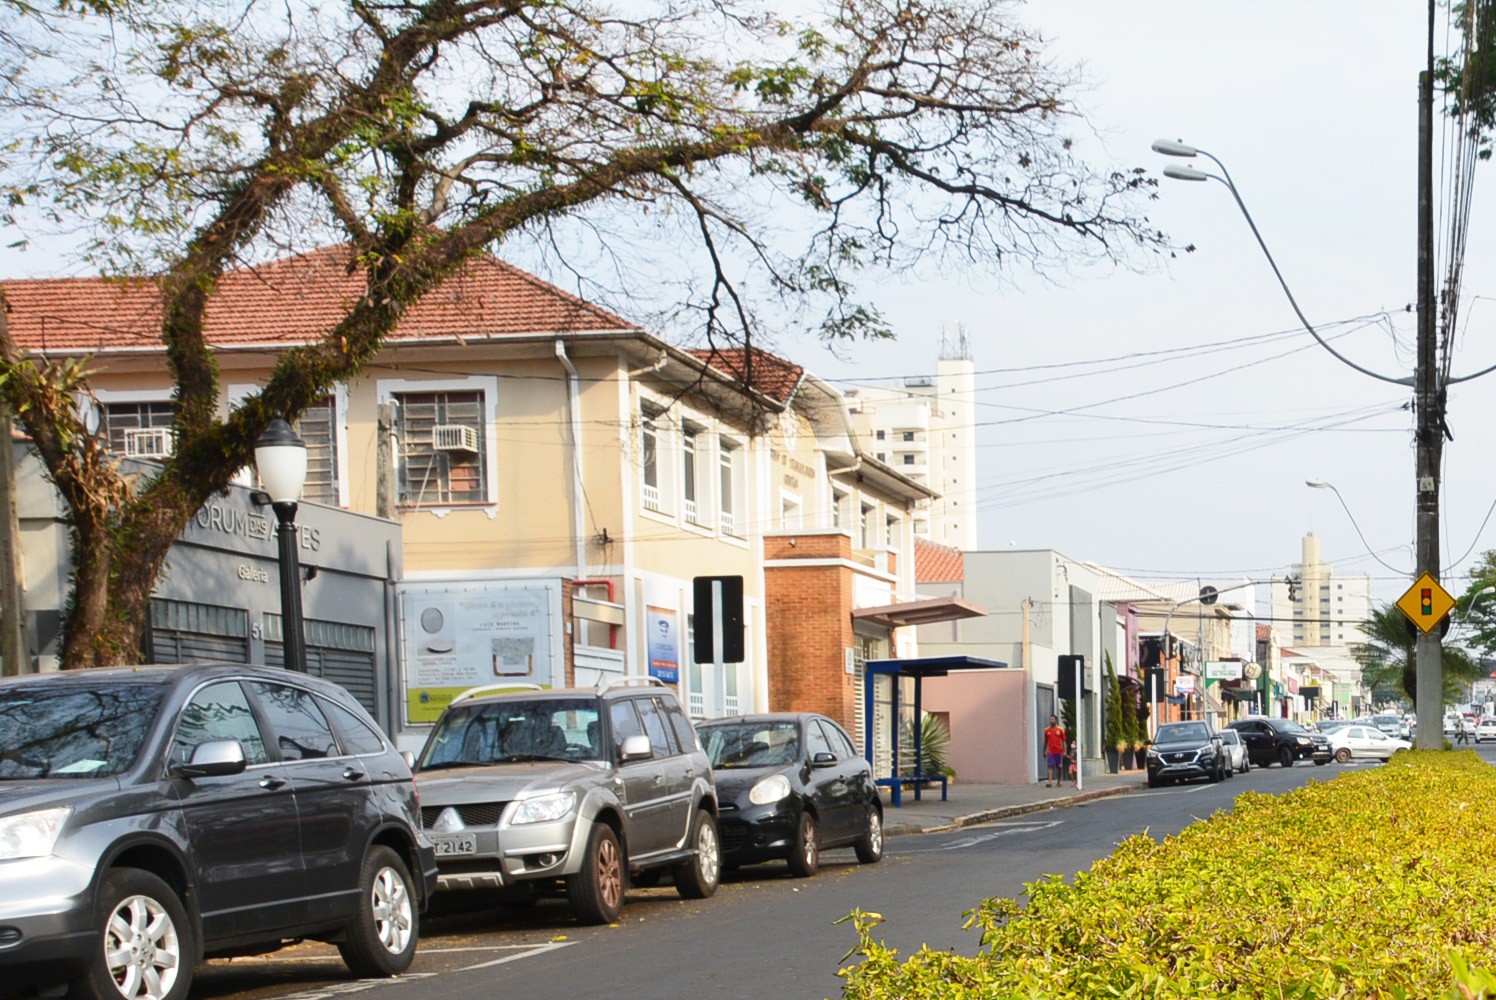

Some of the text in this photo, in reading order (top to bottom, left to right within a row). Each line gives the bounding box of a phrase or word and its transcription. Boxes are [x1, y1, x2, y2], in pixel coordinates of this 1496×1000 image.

[190, 503, 248, 537] ORUM
[238, 564, 269, 583] Galeria
[252, 623, 264, 641] 51
[434, 841, 472, 853] T-2142
